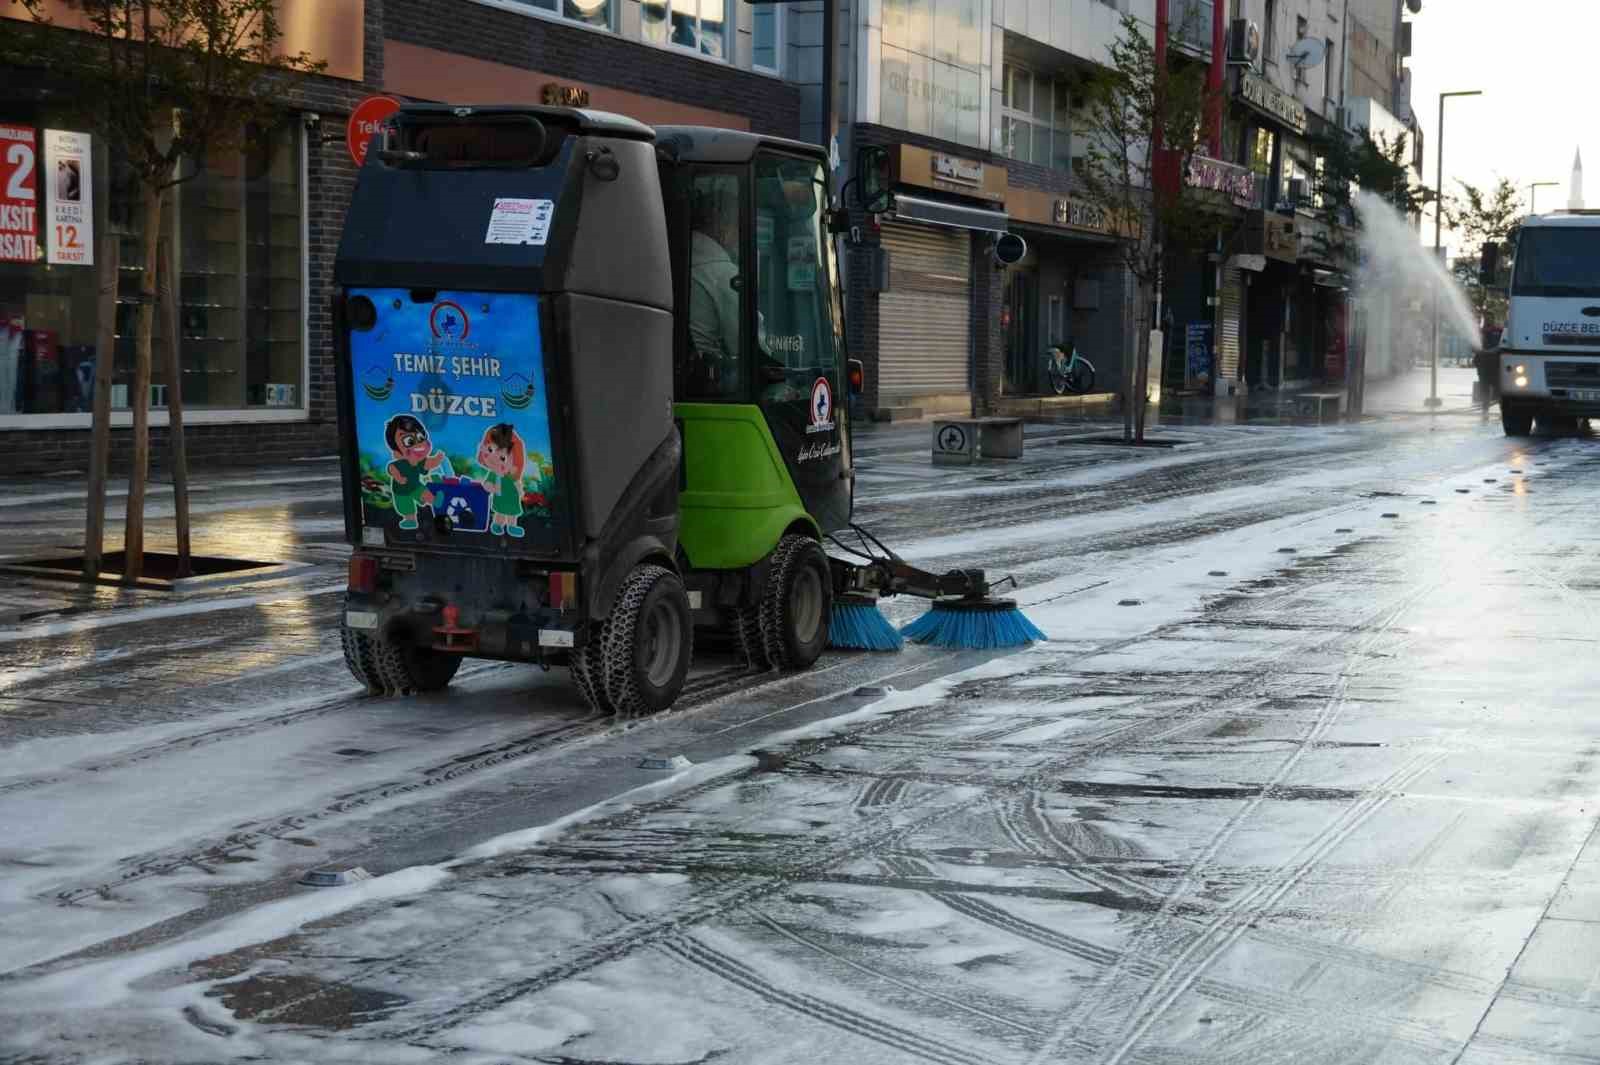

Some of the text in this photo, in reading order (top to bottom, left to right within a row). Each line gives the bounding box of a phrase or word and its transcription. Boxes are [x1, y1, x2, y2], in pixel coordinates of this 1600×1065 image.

[0, 201, 35, 232] KSİT
[56, 224, 80, 249] 12
[393, 350, 501, 380] TEMİZ ŞEHİR
[411, 388, 497, 417] DÜZCE
